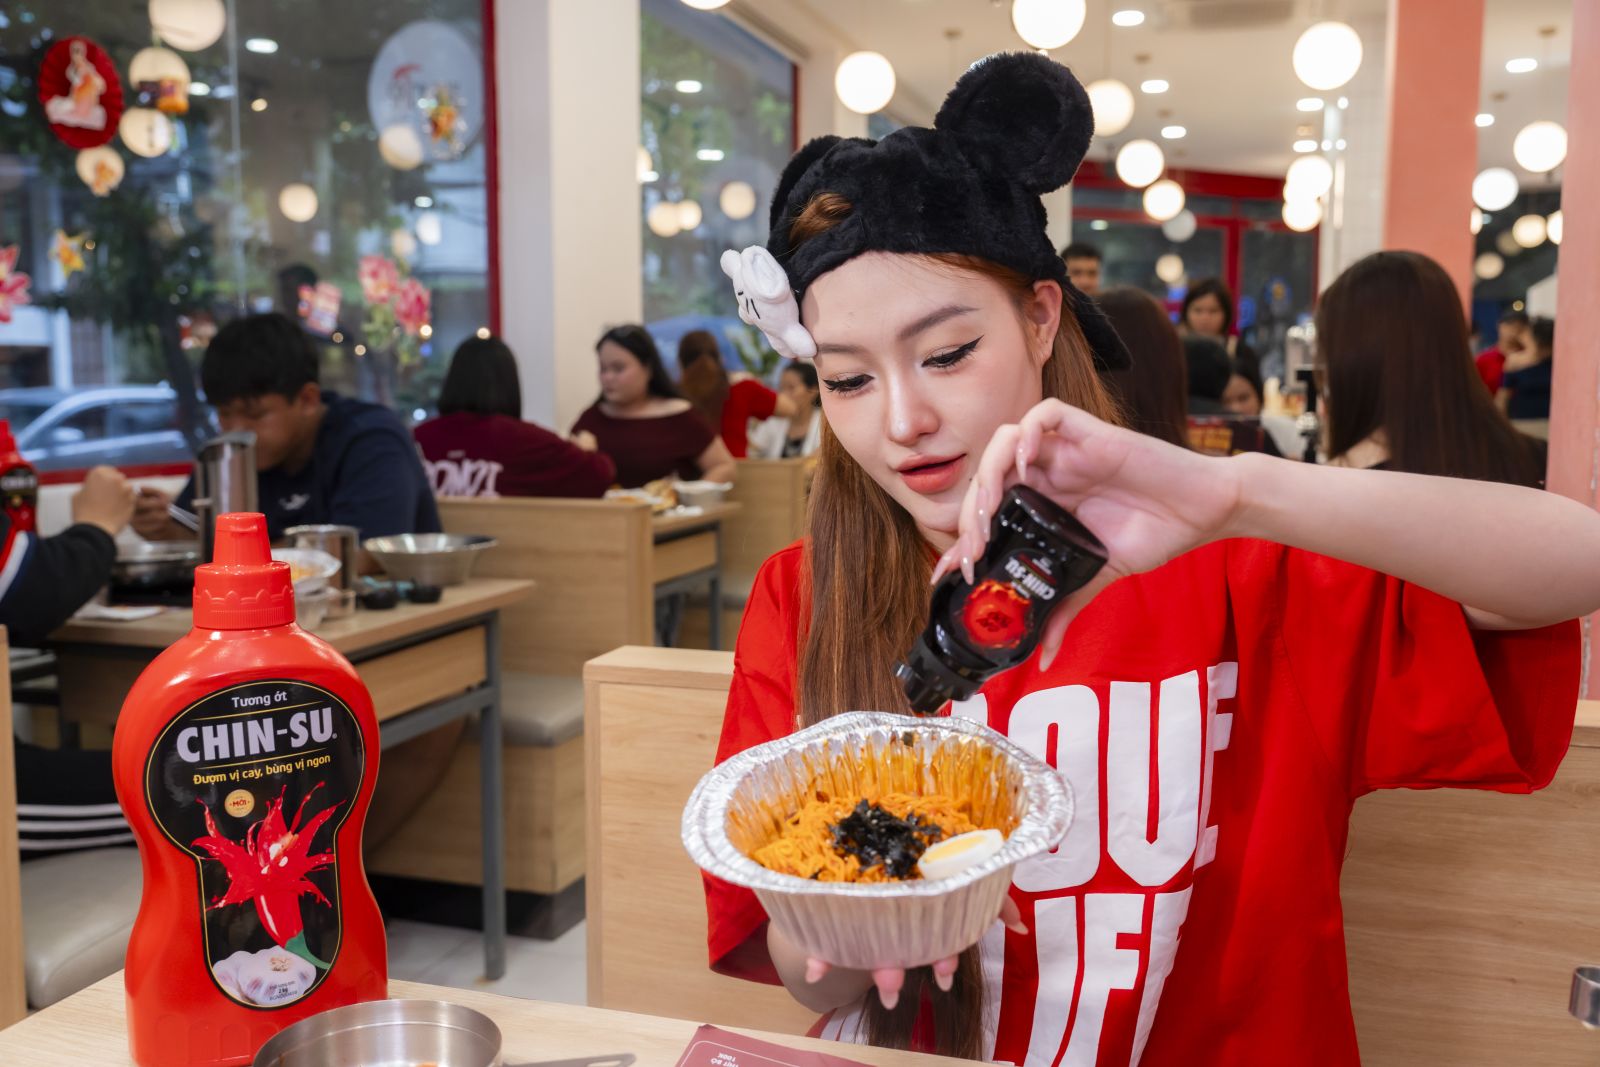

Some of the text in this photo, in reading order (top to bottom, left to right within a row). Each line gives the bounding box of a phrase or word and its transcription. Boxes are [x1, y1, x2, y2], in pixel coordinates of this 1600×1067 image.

[1004, 556, 1055, 600] CHIN-SU
[231, 690, 287, 708] Tương ớt
[176, 707, 334, 763] CHIN-SU
[192, 755, 331, 785] Đượm vị cay, bùng vị ngon
[951, 662, 1239, 892] OVE
